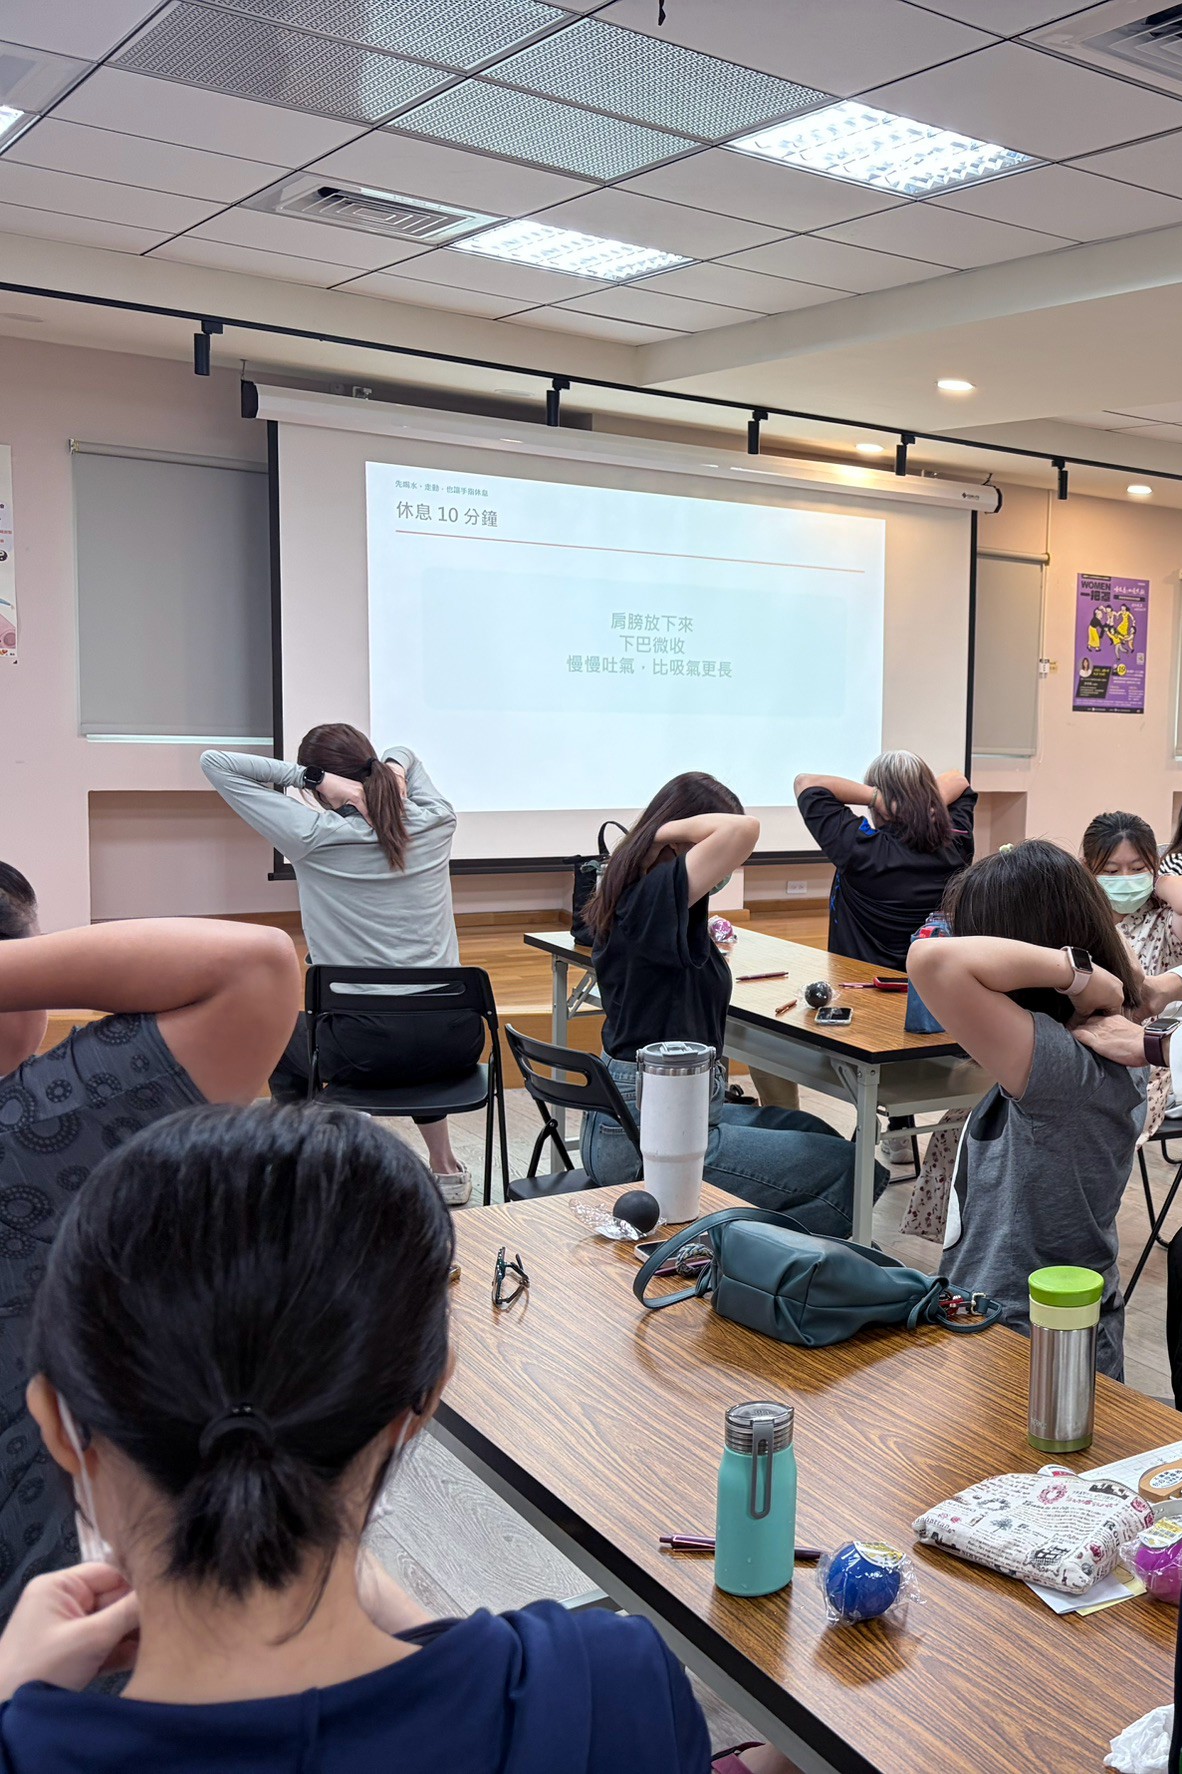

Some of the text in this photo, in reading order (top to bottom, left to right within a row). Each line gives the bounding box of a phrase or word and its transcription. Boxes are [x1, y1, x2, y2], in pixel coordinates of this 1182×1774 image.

[396, 500, 498, 527] 休息 10 分鐘
[1081, 581, 1111, 590] WOMEN
[611, 612, 693, 633] 肩膀放下來
[619, 634, 685, 655] 下巴微收
